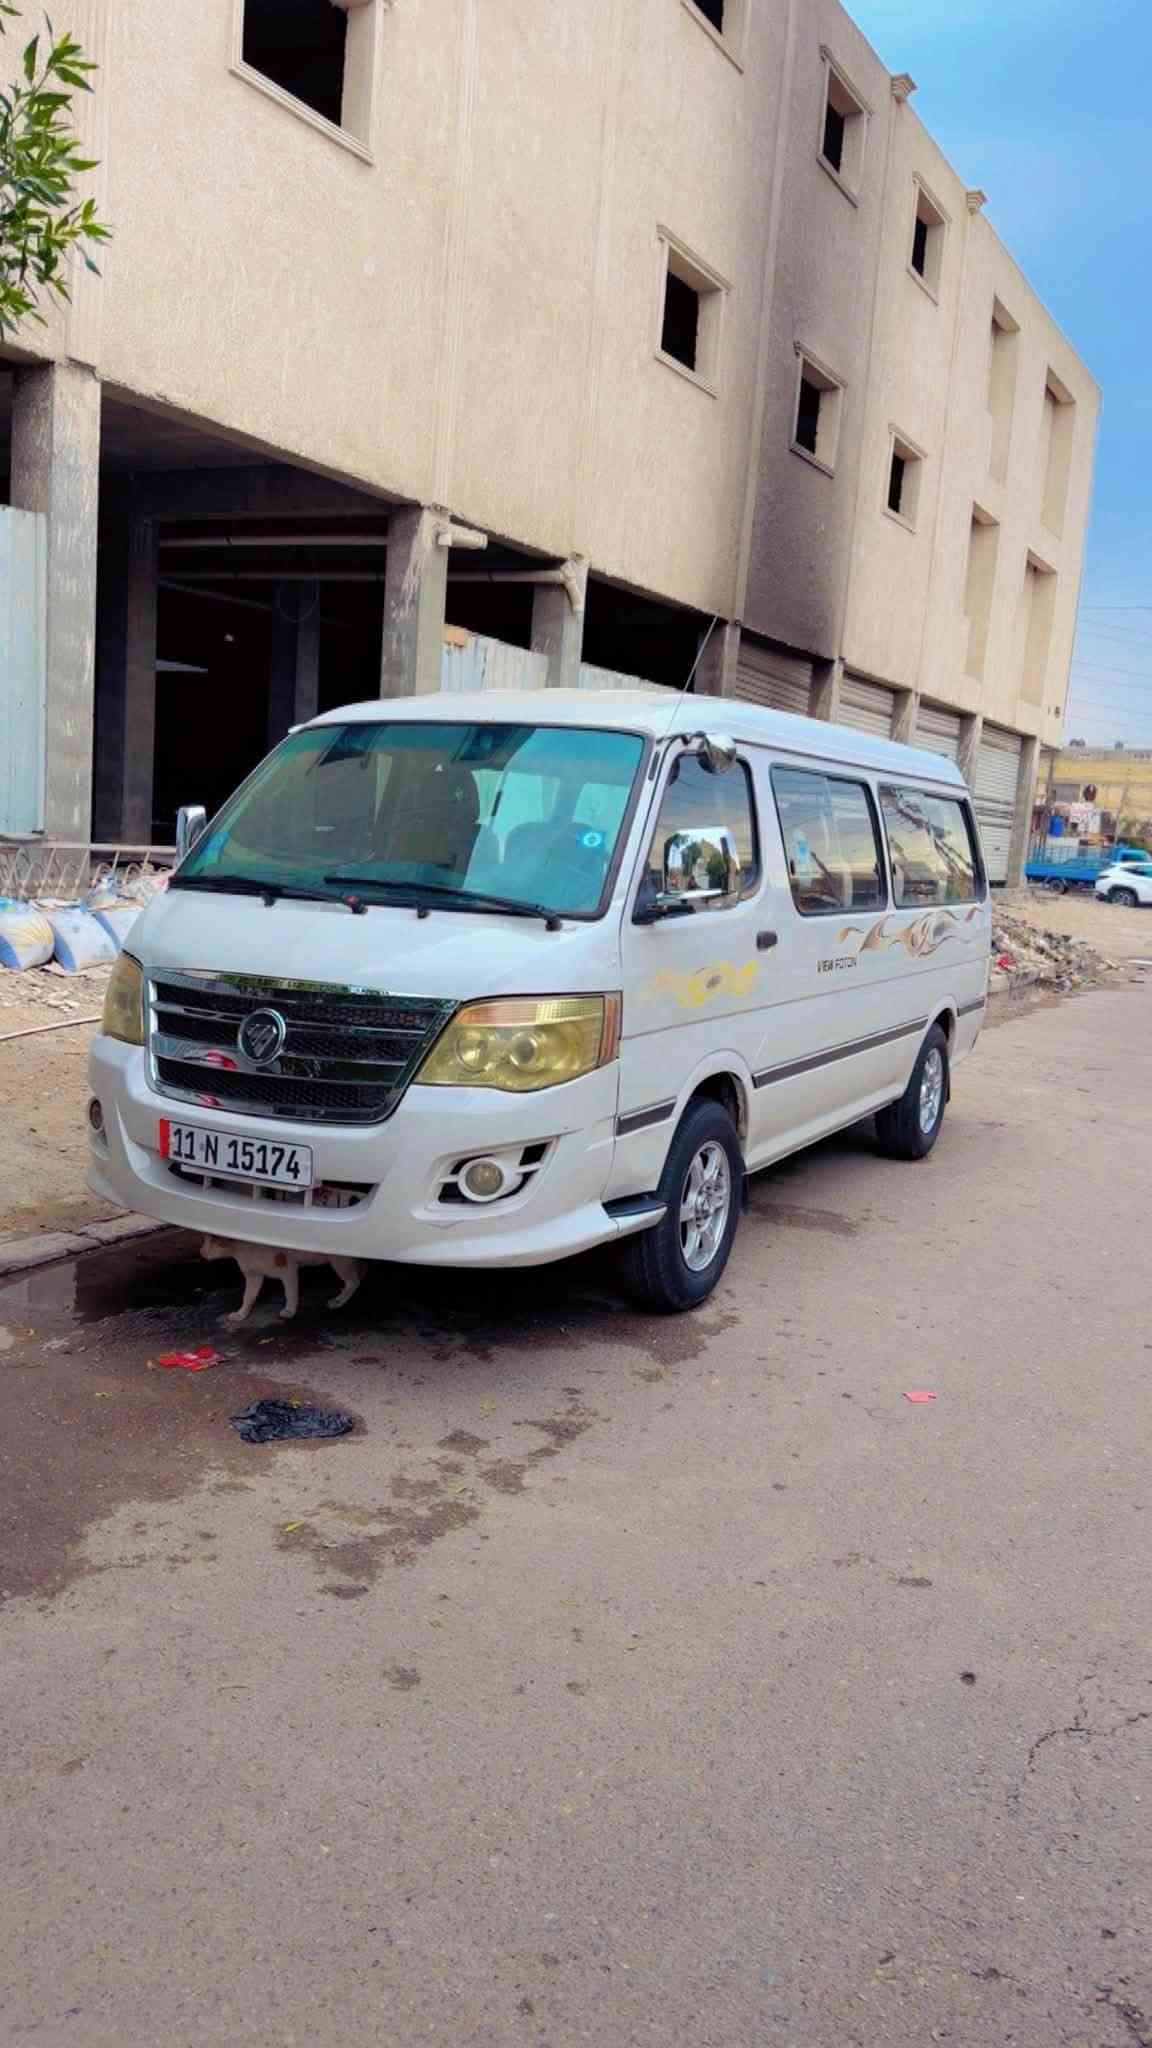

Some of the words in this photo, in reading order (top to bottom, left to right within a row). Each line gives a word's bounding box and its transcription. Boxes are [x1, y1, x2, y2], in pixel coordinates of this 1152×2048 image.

[173, 1127, 195, 1160] 11
[204, 1134, 219, 1165] N
[227, 1139, 300, 1179] 15174
